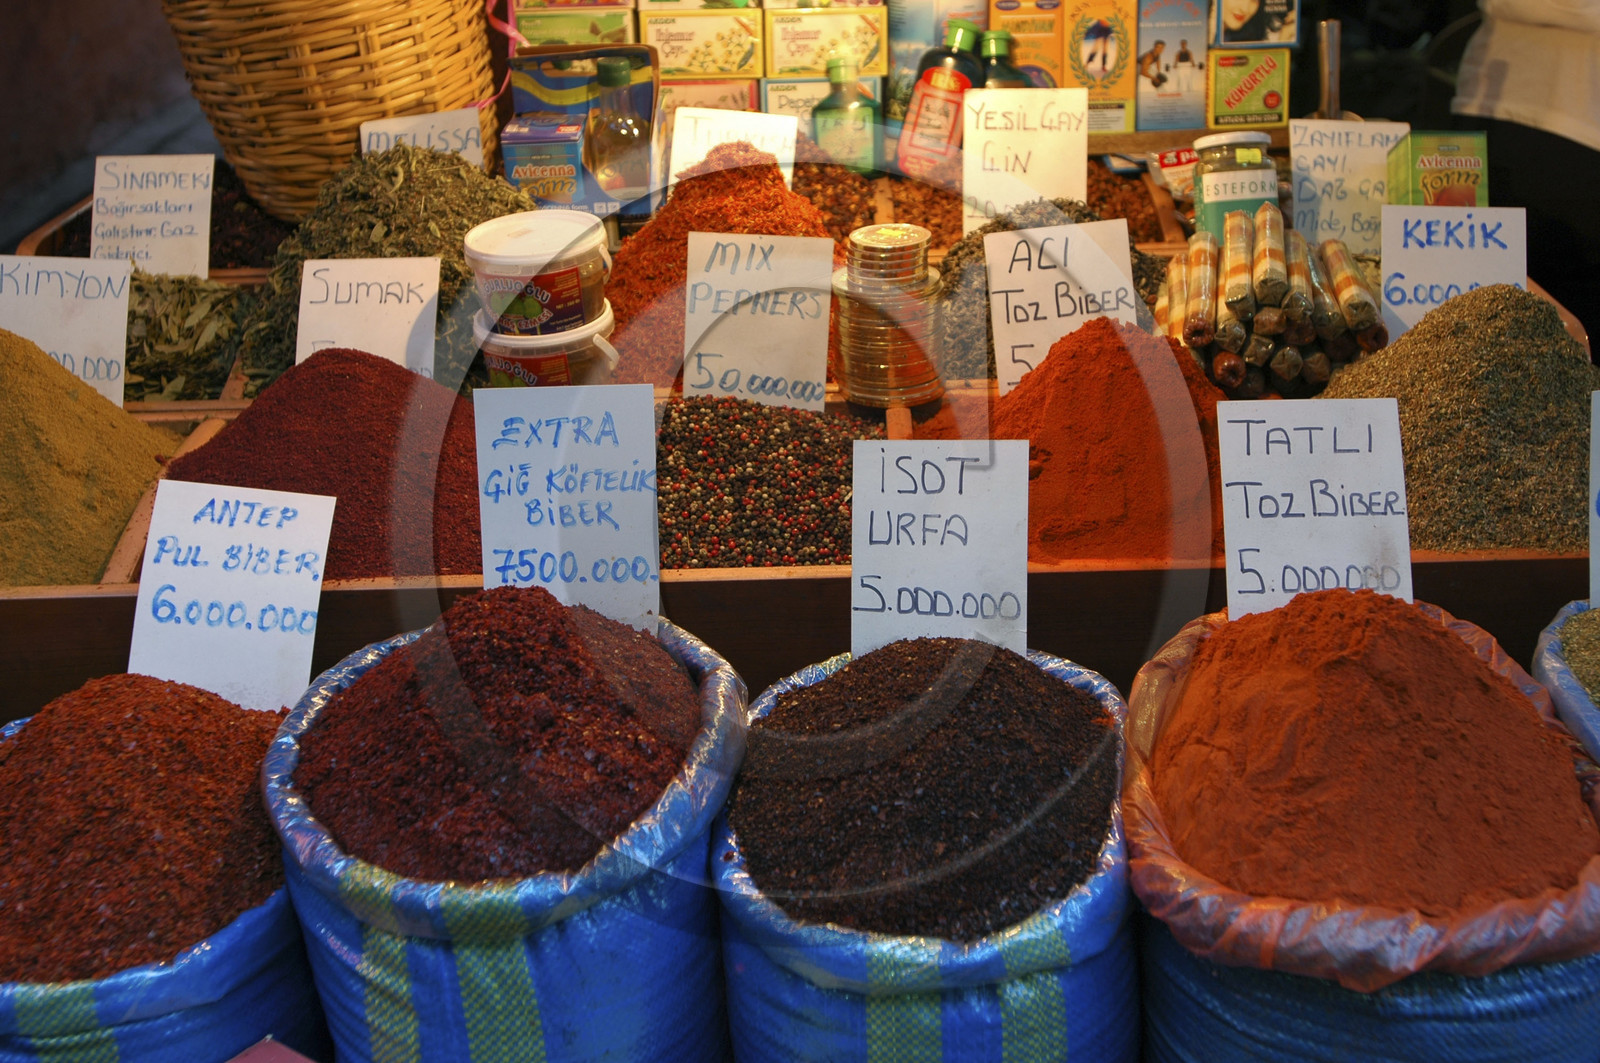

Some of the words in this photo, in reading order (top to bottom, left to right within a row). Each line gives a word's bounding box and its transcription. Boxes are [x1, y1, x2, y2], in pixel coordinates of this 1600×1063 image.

[1224, 54, 1278, 111] KÜKÜRTLÜ
[512, 164, 576, 178] Avicenna
[1417, 155, 1483, 168] Avicenna
[522, 179, 576, 197] orm
[1205, 181, 1278, 197] ESTEFORM
[1420, 170, 1481, 204] form
[1009, 237, 1069, 273] ACI
[309, 268, 424, 304] SUMAK
[492, 411, 619, 450] EXTRA
[1227, 419, 1373, 456] TATLI
[193, 498, 298, 528] ANTEP
[869, 510, 968, 546] URFA
[152, 584, 318, 634] 6.000.000
[852, 575, 1021, 620] 5.000.000
